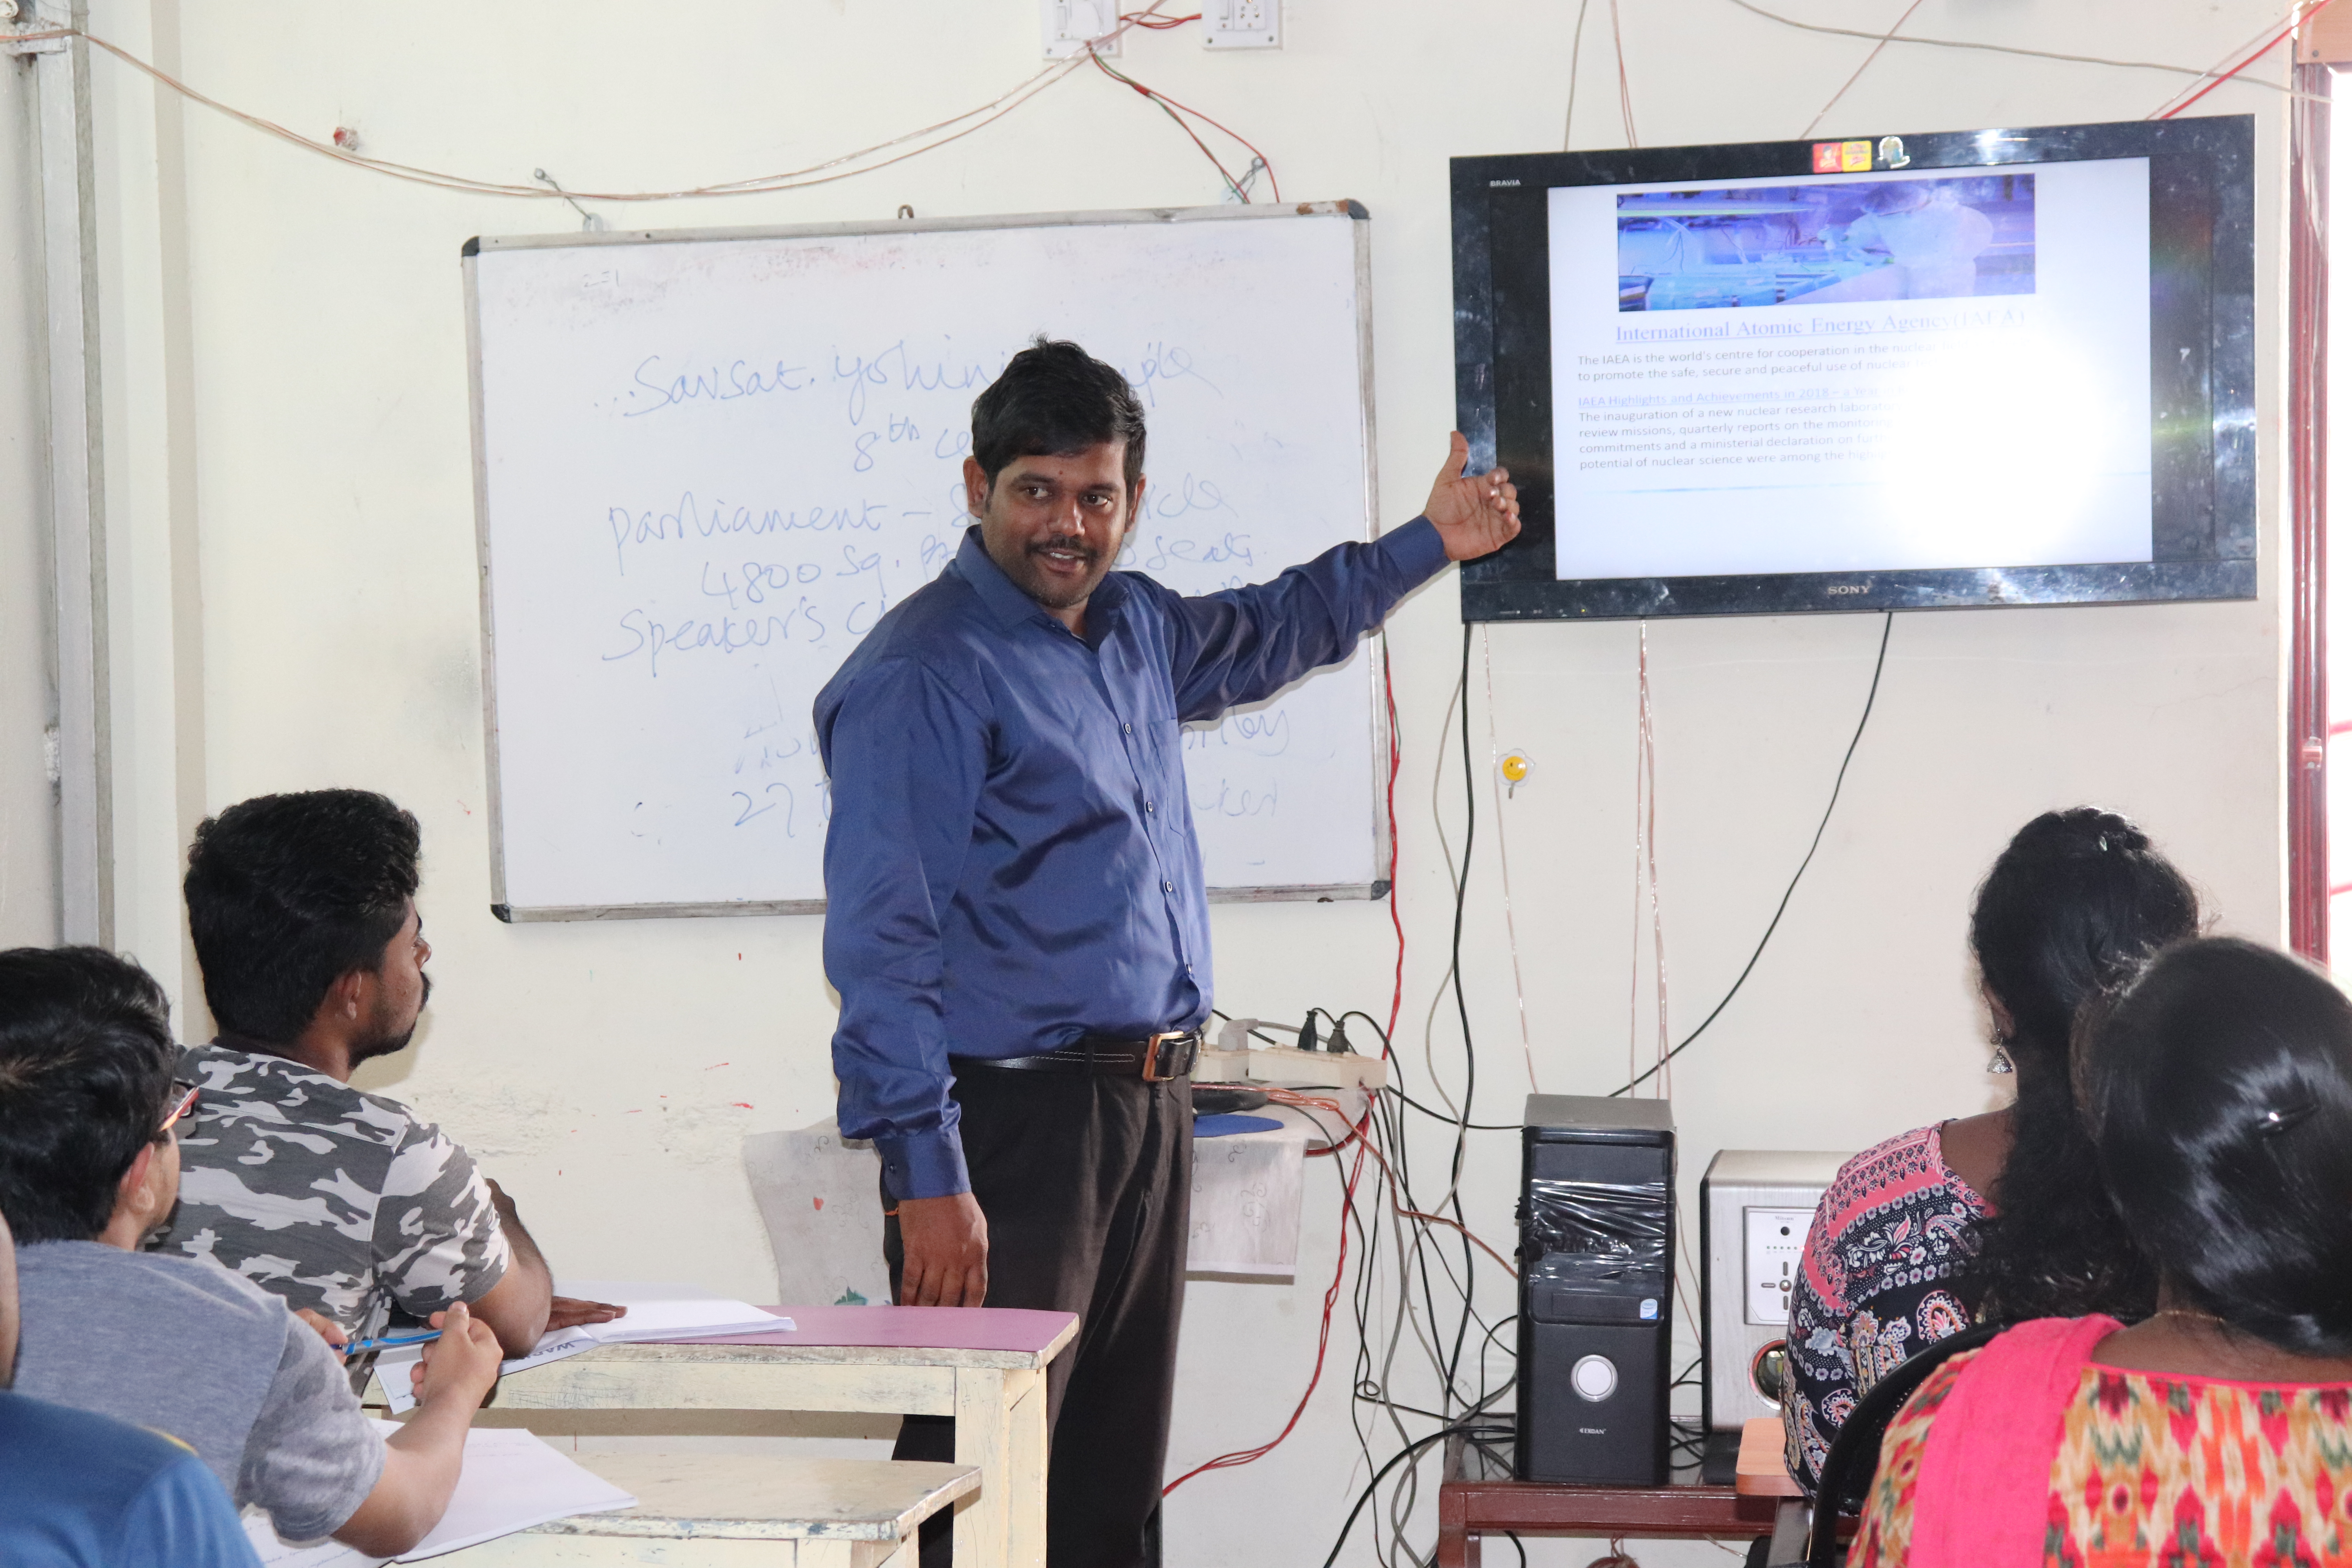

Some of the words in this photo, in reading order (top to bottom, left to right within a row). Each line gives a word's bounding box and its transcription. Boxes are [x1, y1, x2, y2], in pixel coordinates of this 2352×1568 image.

[1489, 178, 1521, 187] BRAVIA
[1616, 321, 1730, 341] International
[1736, 319, 1803, 336] Atomic
[1812, 317, 1876, 334] Energy
[1578, 355, 1599, 365] The
[1603, 354, 1630, 364] IAEA
[1634, 354, 1642, 363] is
[1646, 353, 1665, 362] the
[1669, 350, 1711, 361] world's
[1715, 351, 1753, 360] centre
[1757, 348, 1774, 358] for
[1777, 347, 1849, 358] cooperation
[1869, 343, 1889, 353] the
[1893, 342, 1936, 352] nuclear
[1578, 373, 1590, 381] to
[1593, 371, 1644, 382] promote
[1648, 368, 1668, 378] the
[1671, 367, 1698, 378] safe,
[1703, 367, 1741, 376] secure
[1745, 364, 1767, 374] and
[1771, 361, 1822, 376] peaceful
[1850, 360, 1862, 370] of
[1867, 359, 1911, 370] nuclear
[1579, 397, 1606, 406] IAEA
[1609, 394, 1667, 407] Highlights
[1671, 393, 1693, 403] and
[1697, 390, 1780, 402] Achievements
[1785, 389, 1795, 398] in
[1800, 388, 1829, 399] 2018
[1854, 386, 1878, 396] Year
[1579, 412, 1600, 422] The
[1604, 410, 1678, 422] inauguration
[1682, 408, 1694, 418] of
[1738, 406, 1781, 416] nuclear
[1786, 403, 1836, 414] research
[1579, 429, 1618, 437] review
[1622, 425, 1675, 436] missions,
[1679, 423, 1733, 436] quarterly
[1738, 422, 1780, 433] reports
[1804, 420, 1823, 429] the
[1828, 418, 1894, 428] monitoring
[1579, 442, 1661, 453] commitments
[1665, 440, 1686, 450] and
[1701, 437, 1763, 448] ministerial
[1767, 436, 1833, 446] declaration
[1580, 457, 1632, 471] potential
[1636, 457, 1647, 467] of
[1652, 456, 1695, 466] nuclear
[1700, 455, 1742, 465] science
[1747, 455, 1776, 463] were
[1780, 453, 1821, 463] among
[1825, 450, 1844, 460] the
[702, 561, 821, 610] 4800
[1827, 586, 1871, 595] SONY
